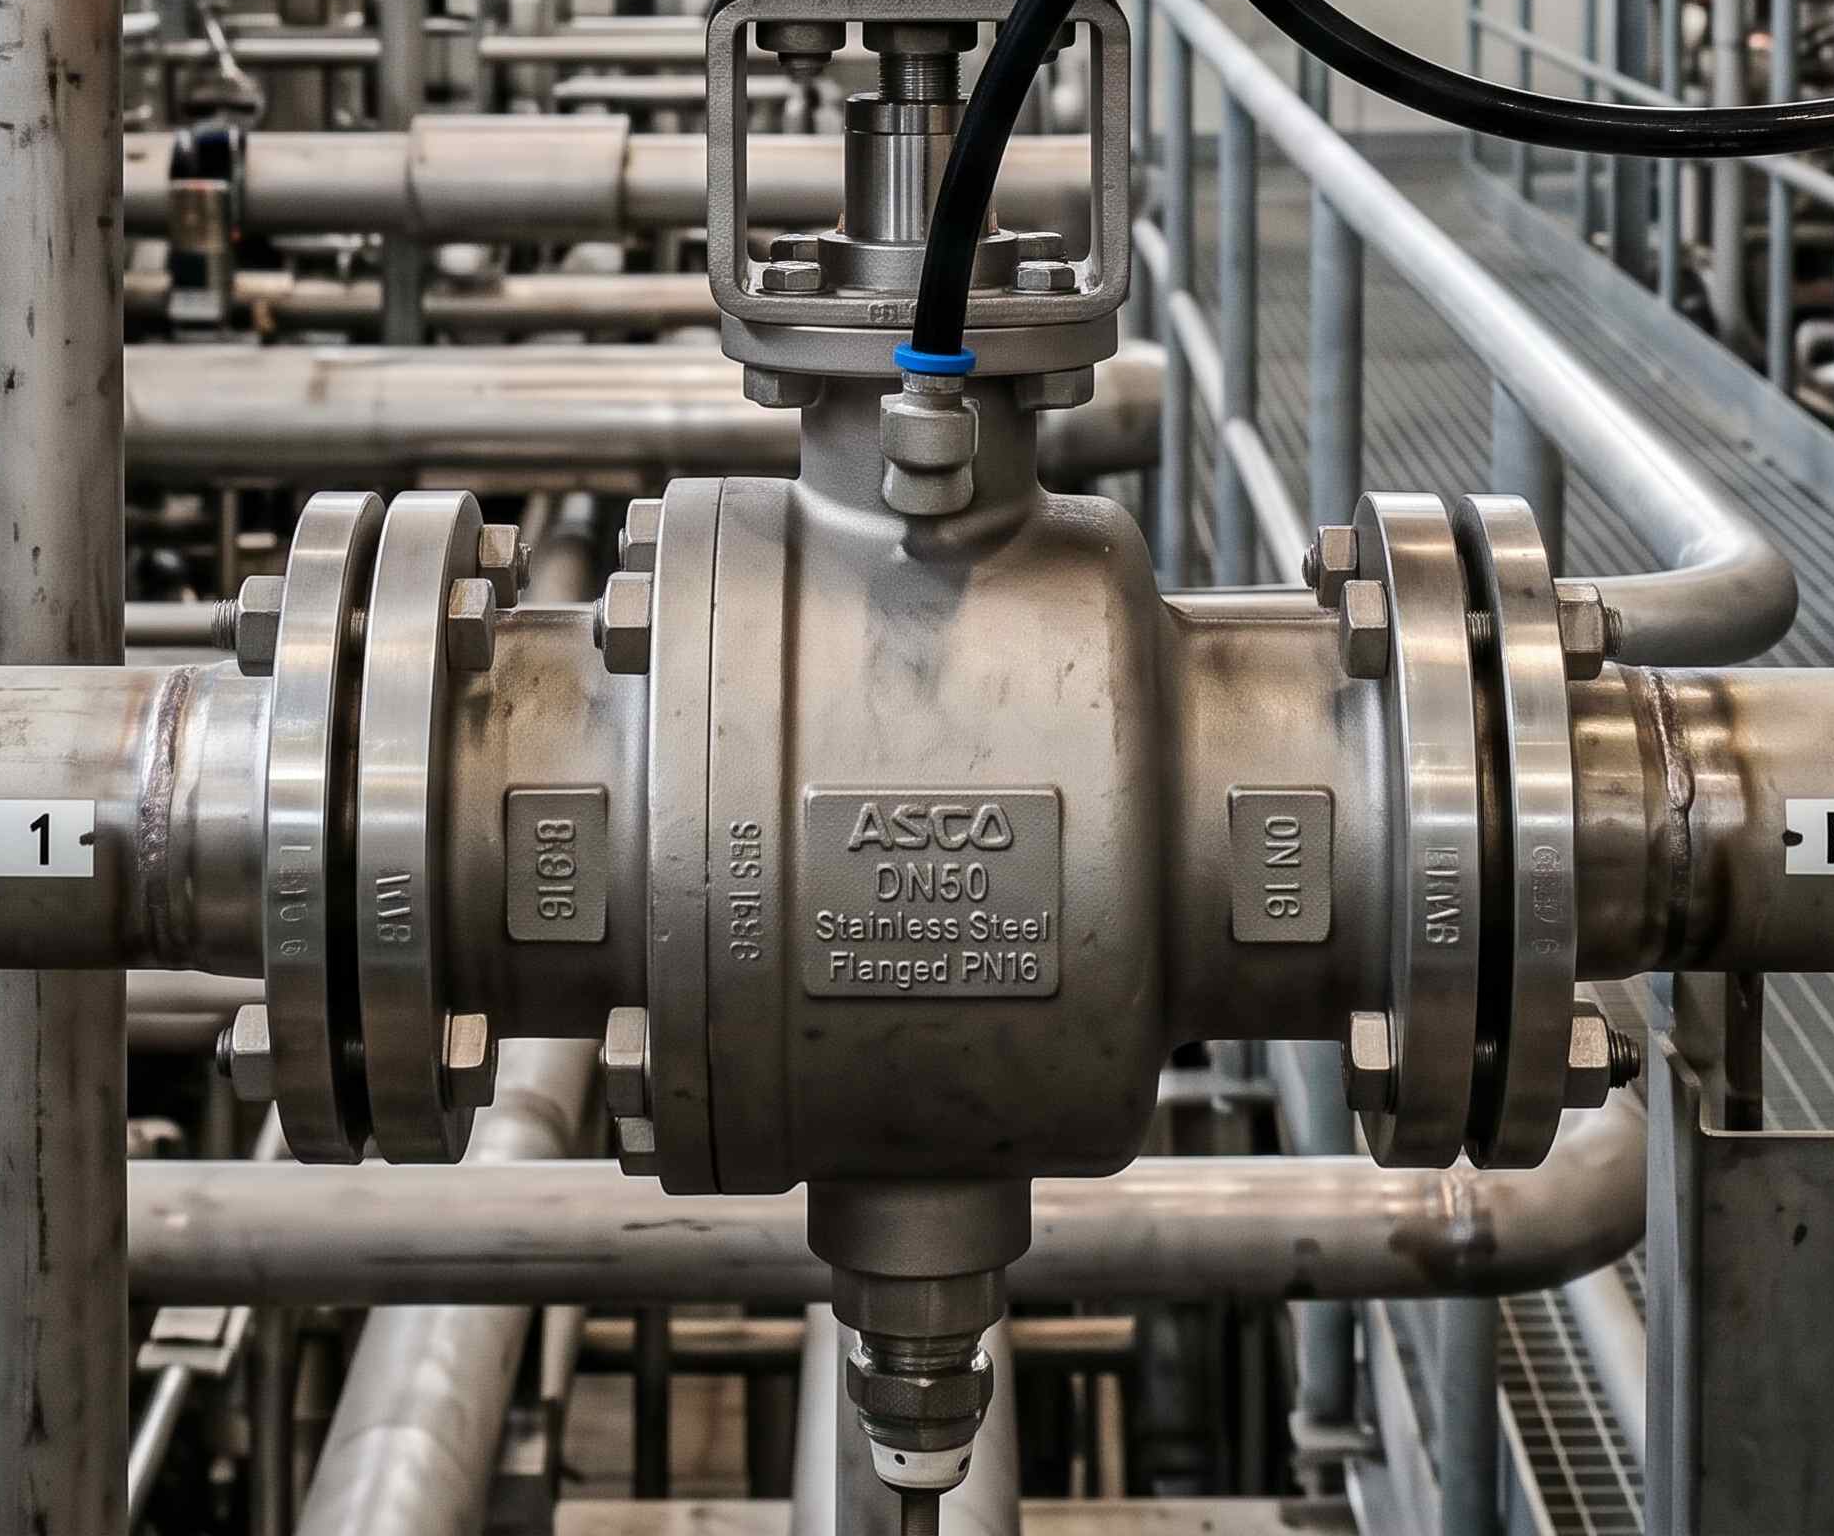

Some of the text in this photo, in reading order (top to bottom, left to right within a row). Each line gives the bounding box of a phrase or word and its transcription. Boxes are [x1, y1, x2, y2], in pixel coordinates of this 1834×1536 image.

[29, 813, 50, 866] 1
[847, 802, 1014, 851] ASCO
[875, 861, 989, 903] DN50
[1264, 881, 1301, 918] 16
[815, 910, 1050, 941] Stainless Steel
[828, 951, 1039, 989] Flanged PN16
